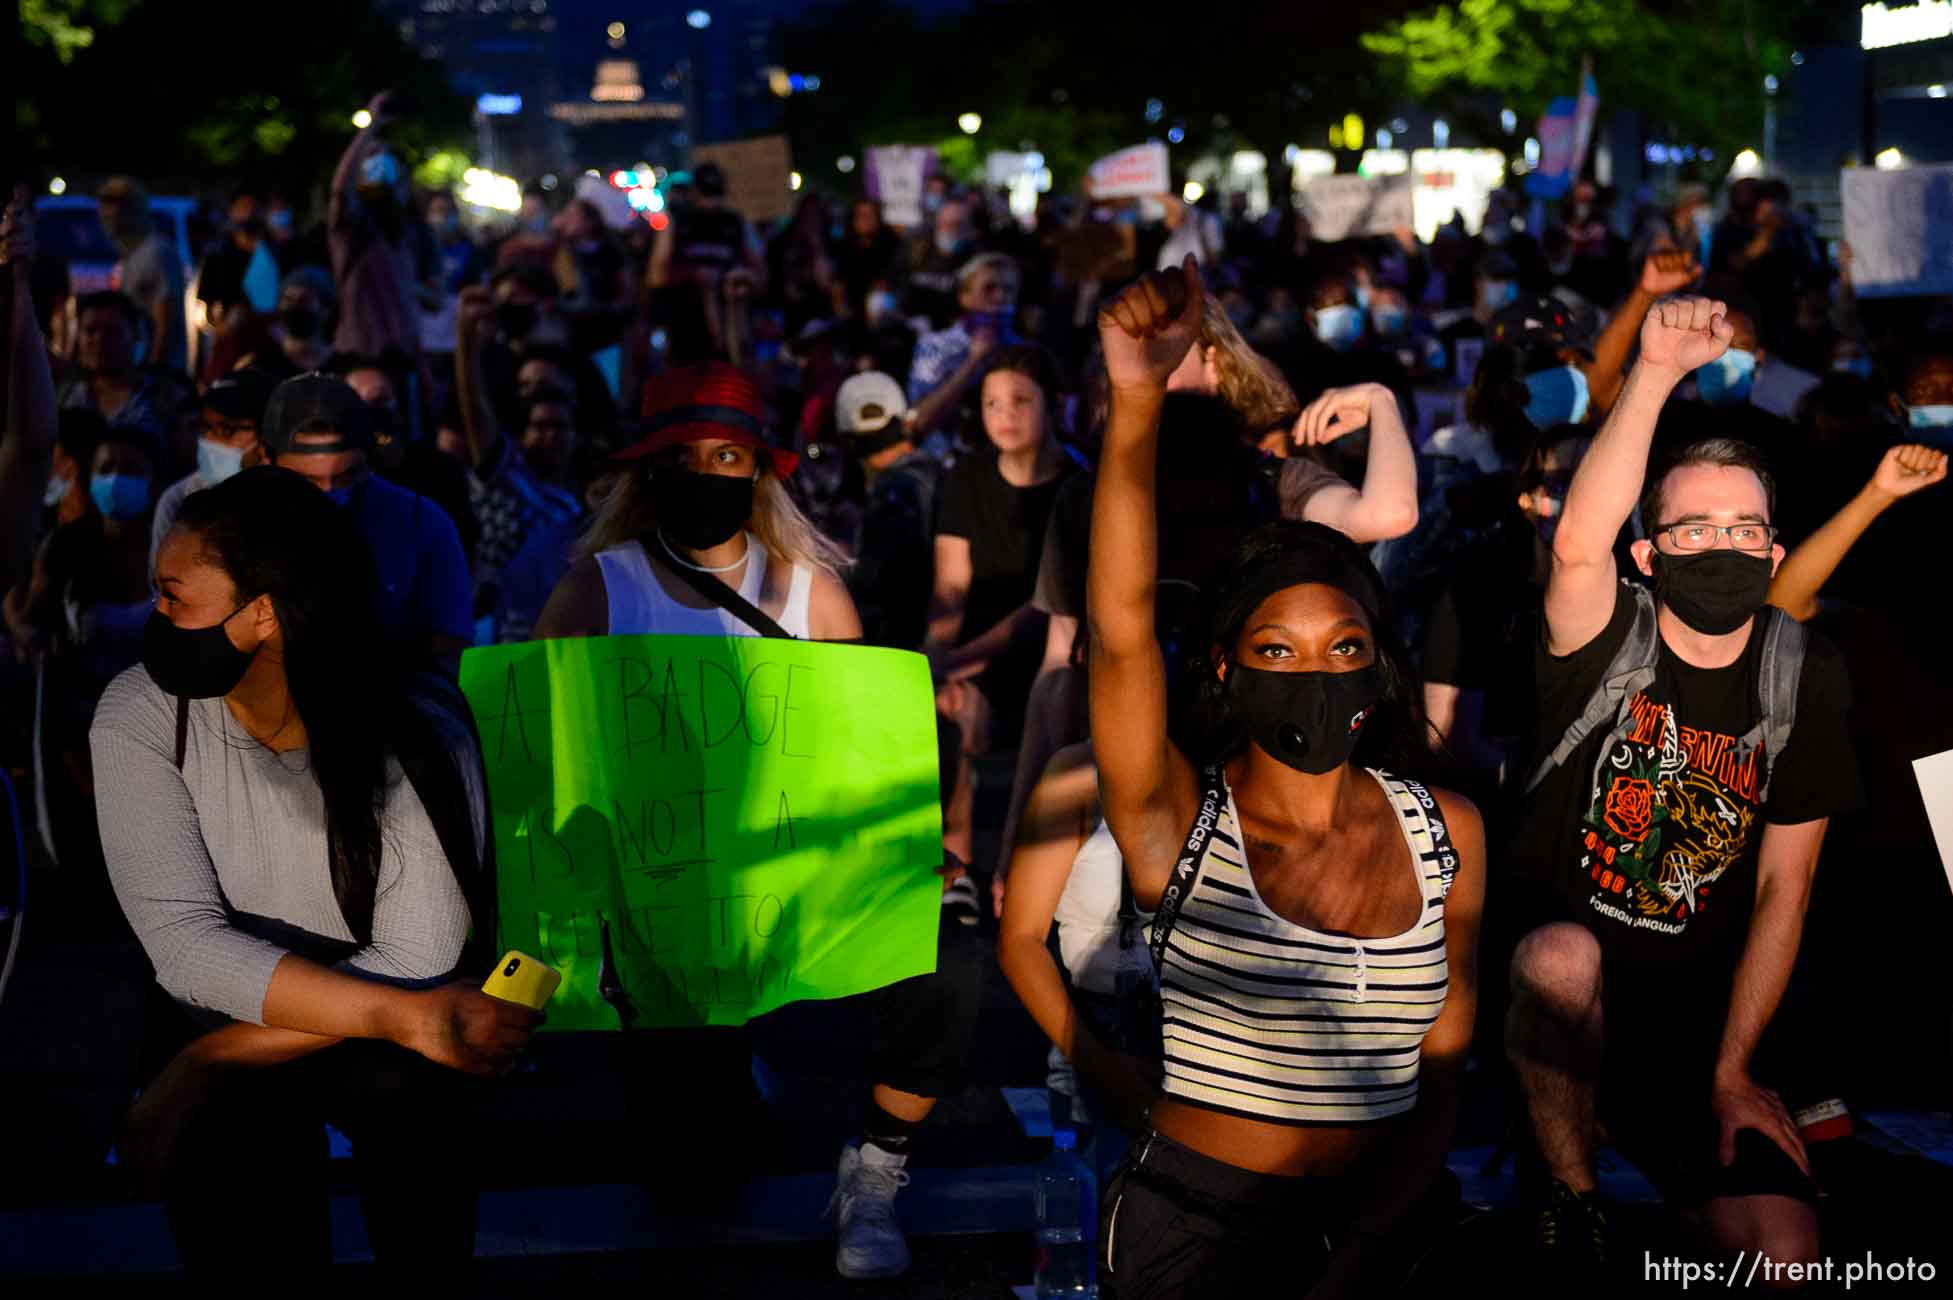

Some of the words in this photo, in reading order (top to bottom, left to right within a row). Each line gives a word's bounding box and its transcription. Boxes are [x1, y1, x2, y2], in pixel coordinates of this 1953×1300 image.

[488, 661, 551, 764] A
[604, 656, 817, 760] BADGE
[510, 805, 575, 886] IS
[612, 786, 729, 864] NOT
[769, 789, 810, 849] A
[706, 894, 784, 946] TO
